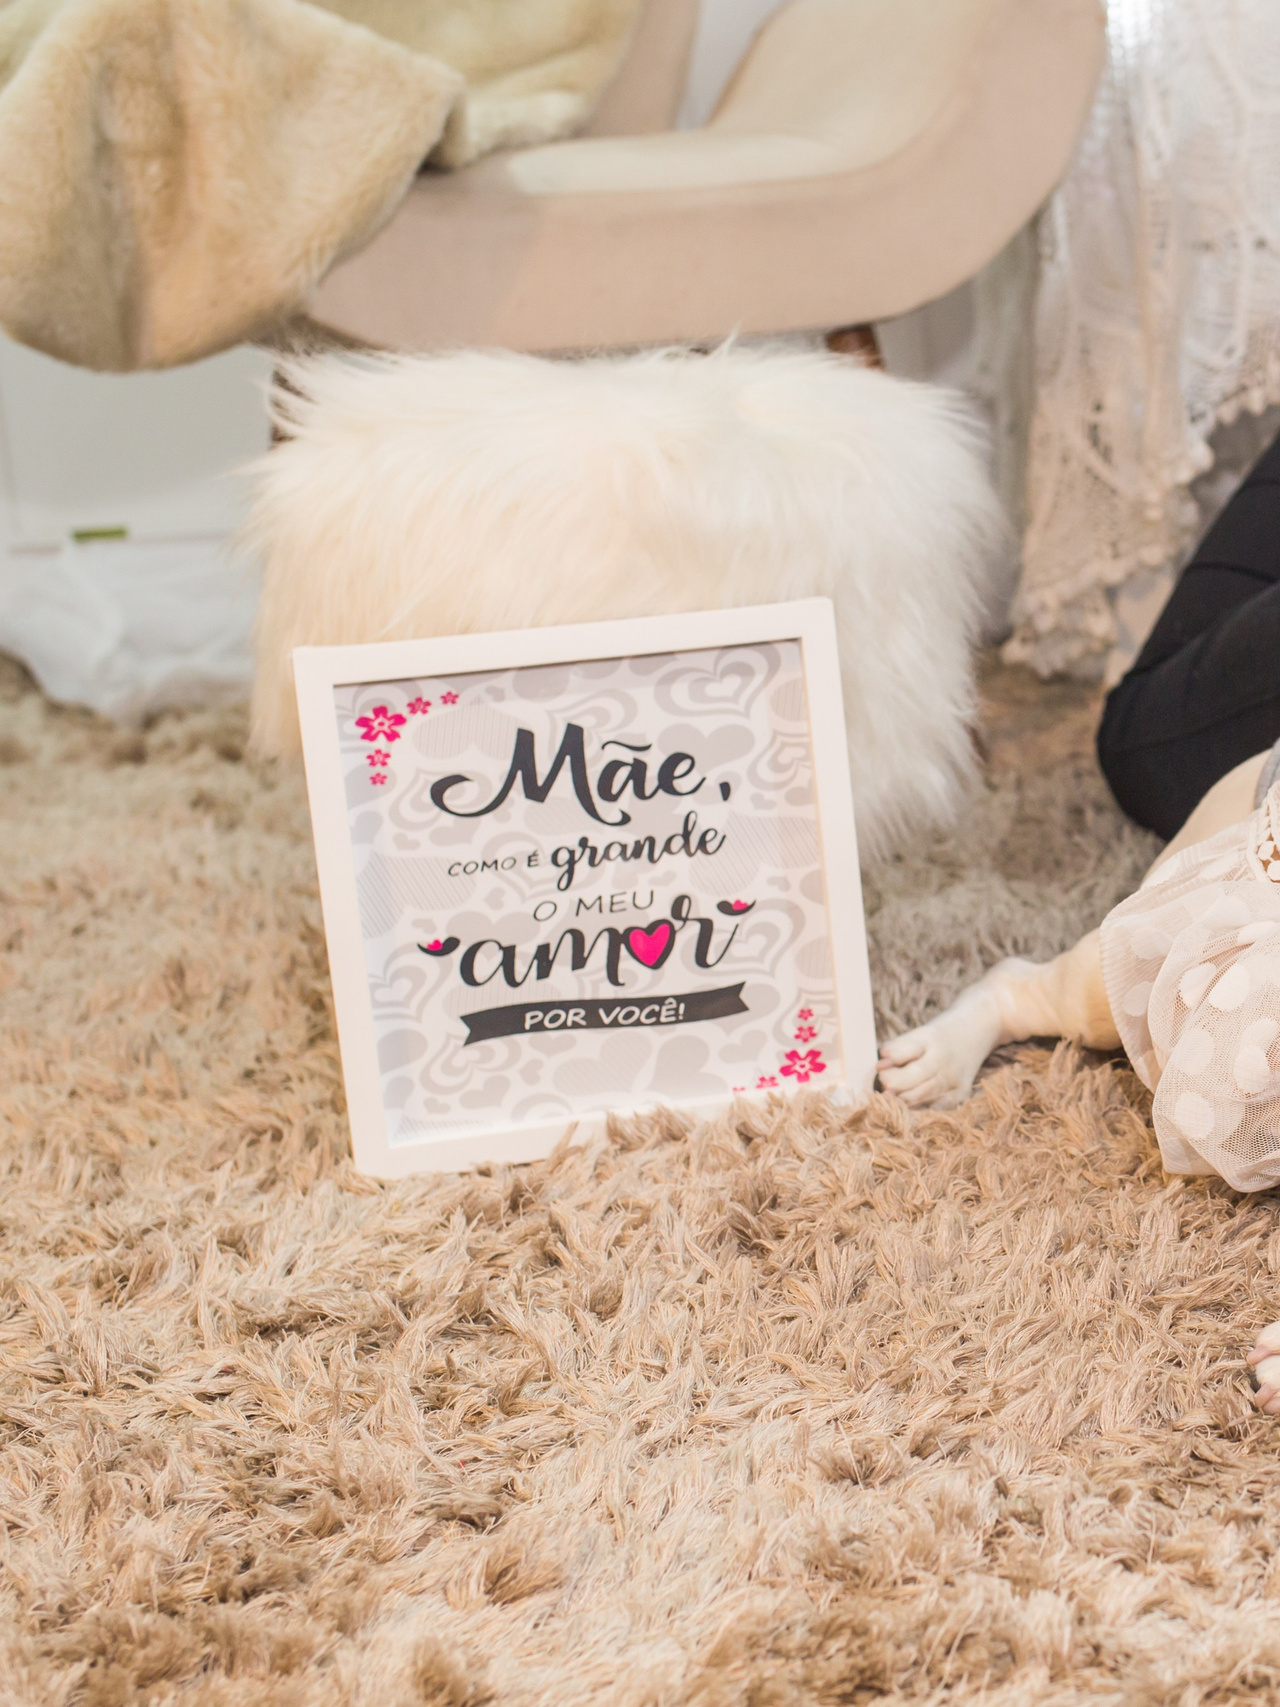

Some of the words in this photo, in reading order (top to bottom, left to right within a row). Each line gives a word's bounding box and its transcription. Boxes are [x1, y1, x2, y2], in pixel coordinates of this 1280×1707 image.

[430, 723, 731, 826] Mãe,
[447, 856, 517, 878] COMO
[526, 849, 541, 869] É
[551, 810, 727, 892] grande
[459, 894, 740, 988] amor
[533, 901, 558, 922] O
[575, 889, 655, 917] MEU
[524, 1004, 587, 1030] POR
[598, 997, 686, 1026] VOCÊ!
